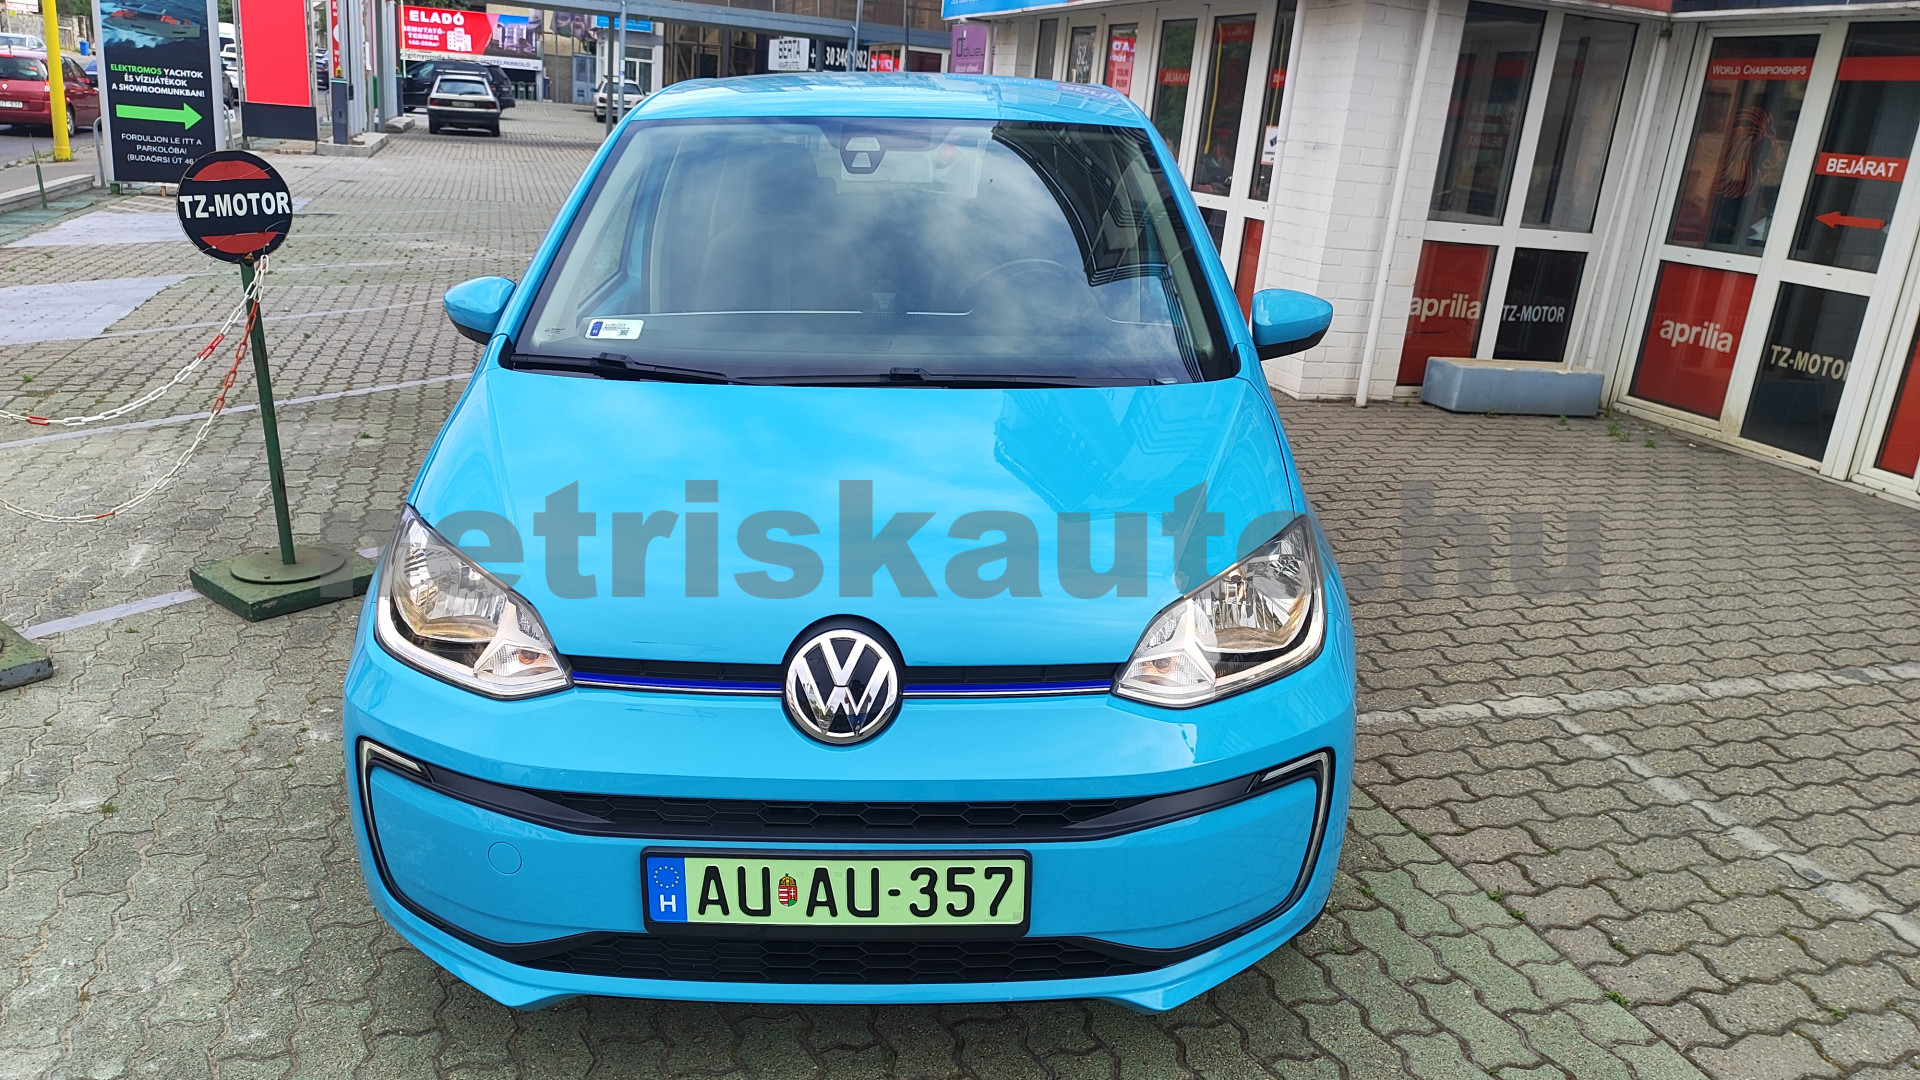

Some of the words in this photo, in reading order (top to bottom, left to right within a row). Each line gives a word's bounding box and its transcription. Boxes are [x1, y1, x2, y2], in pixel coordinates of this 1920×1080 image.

[409, 10, 464, 25] ELADÓ
[778, 39, 801, 59] BERTA
[110, 63, 162, 75] ELEKTROMOS
[163, 68, 204, 79] YACHTOK
[124, 72, 134, 82] ÉS
[1712, 65, 1740, 75] WORLD
[1743, 64, 1807, 75] CHAMPIONSHIPS
[111, 83, 118, 91] A
[119, 83, 205, 98] SHOWROOMUNKBAN!
[121, 133, 168, 143] FORDULJON
[136, 144, 187, 155] PARKOLÓBA!
[172, 155, 182, 164] ÚT
[1825, 157, 1899, 178] BEJÁRAT
[179, 192, 291, 219] TZ-MOTOR
[1409, 293, 1482, 323] aprilia
[1501, 304, 1566, 323] TZ-MOTOR
[1659, 319, 1734, 354] aprilia
[697, 865, 771, 917] AU
[805, 867, 1014, 918] AU-357
[659, 894, 677, 913] H
